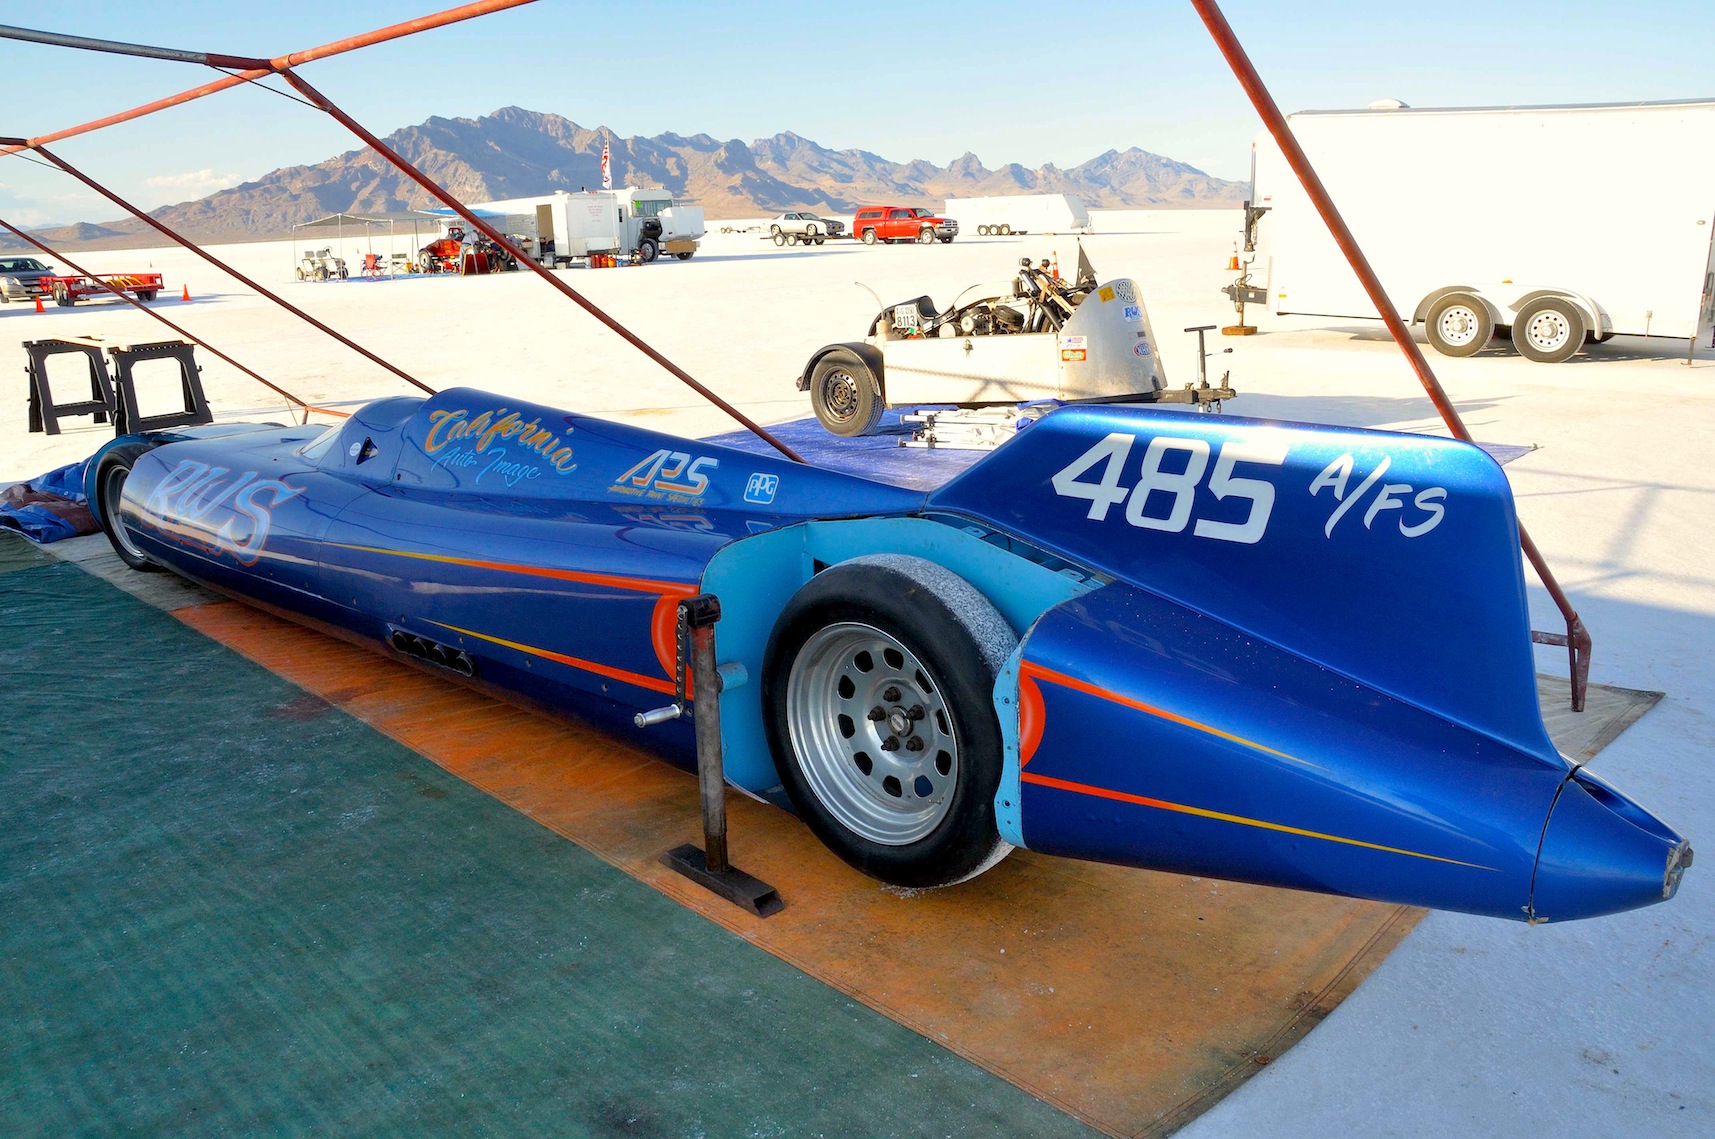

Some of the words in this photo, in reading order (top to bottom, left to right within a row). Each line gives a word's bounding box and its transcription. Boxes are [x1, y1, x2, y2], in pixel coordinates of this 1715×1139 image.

[896, 315, 916, 327] 8113
[424, 407, 578, 476] California
[430, 446, 477, 473] Auto
[475, 447, 541, 487] Image
[615, 448, 719, 497] APS
[747, 474, 776, 497] PPG
[1051, 432, 1291, 544] 485
[1308, 452, 1448, 540] A/FS
[141, 459, 308, 567] RWS
